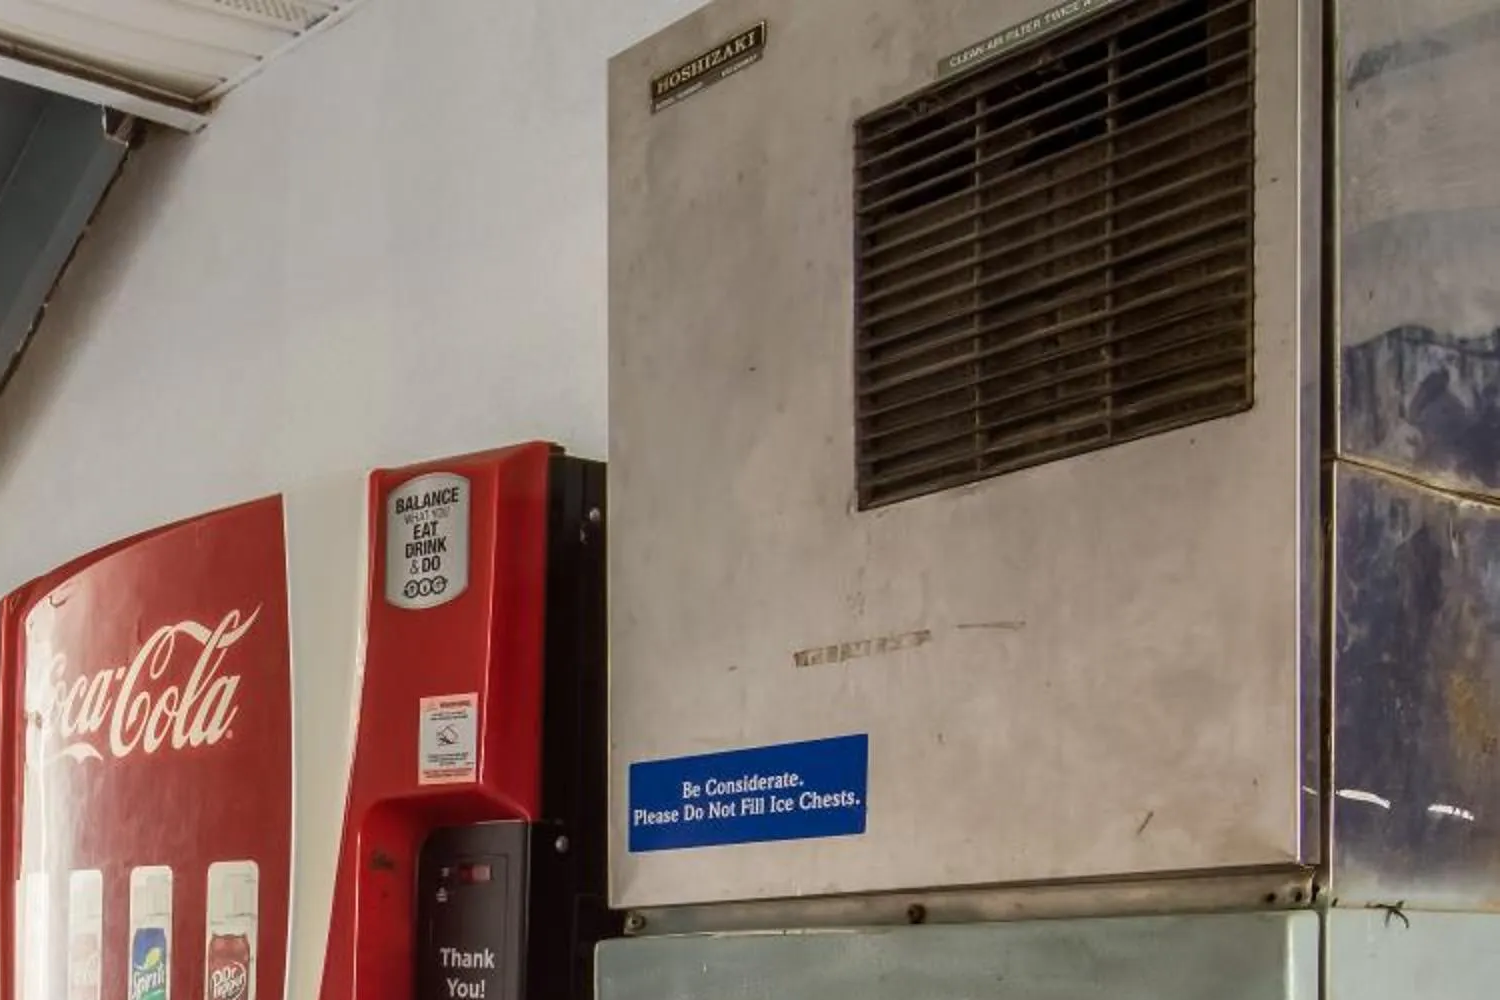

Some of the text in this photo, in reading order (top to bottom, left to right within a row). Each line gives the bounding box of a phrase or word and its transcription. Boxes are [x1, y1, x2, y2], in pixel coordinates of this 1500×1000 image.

[657, 31, 756, 94] HOSHIZAKI
[395, 487, 460, 514] BALANCE
[413, 520, 438, 540] EAT
[405, 536, 447, 559] DRINK
[409, 555, 441, 575] & DO
[682, 772, 805, 799] Be Considerate.
[633, 790, 861, 827] Please Do Not Fill Ice Chests.
[440, 947, 495, 969] Thank
[446, 977, 485, 999] You!
